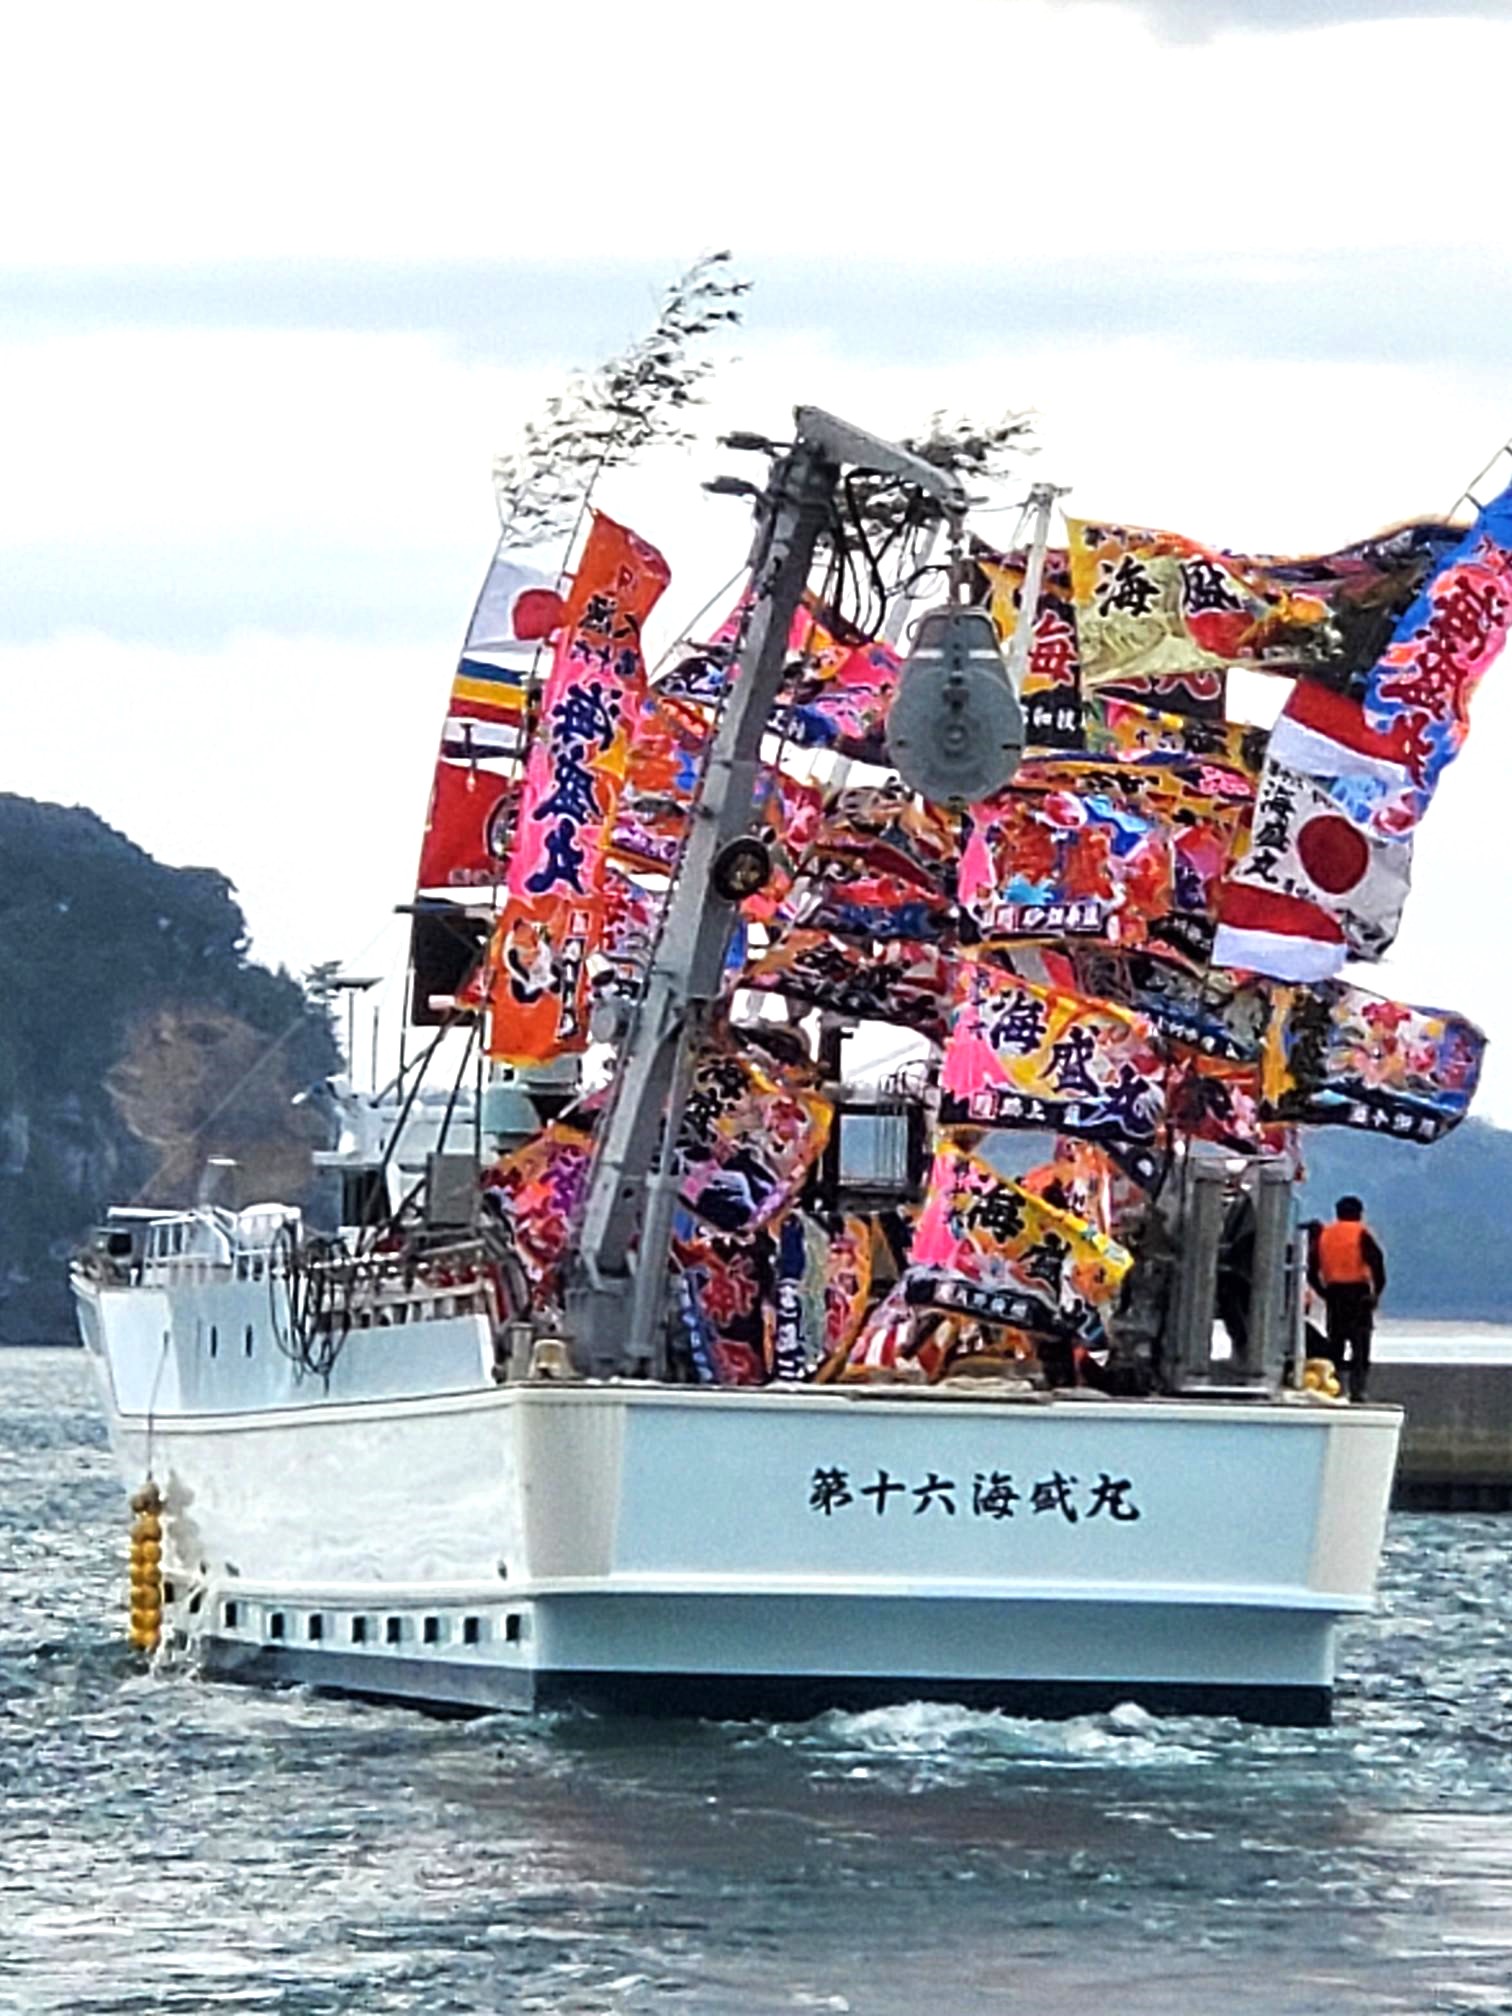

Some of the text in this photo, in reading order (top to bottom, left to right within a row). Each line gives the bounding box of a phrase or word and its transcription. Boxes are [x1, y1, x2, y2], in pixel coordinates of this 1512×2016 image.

[988, 988, 1155, 1137] 海盛丸
[808, 1466, 1141, 1523] 第十六海盛丸
